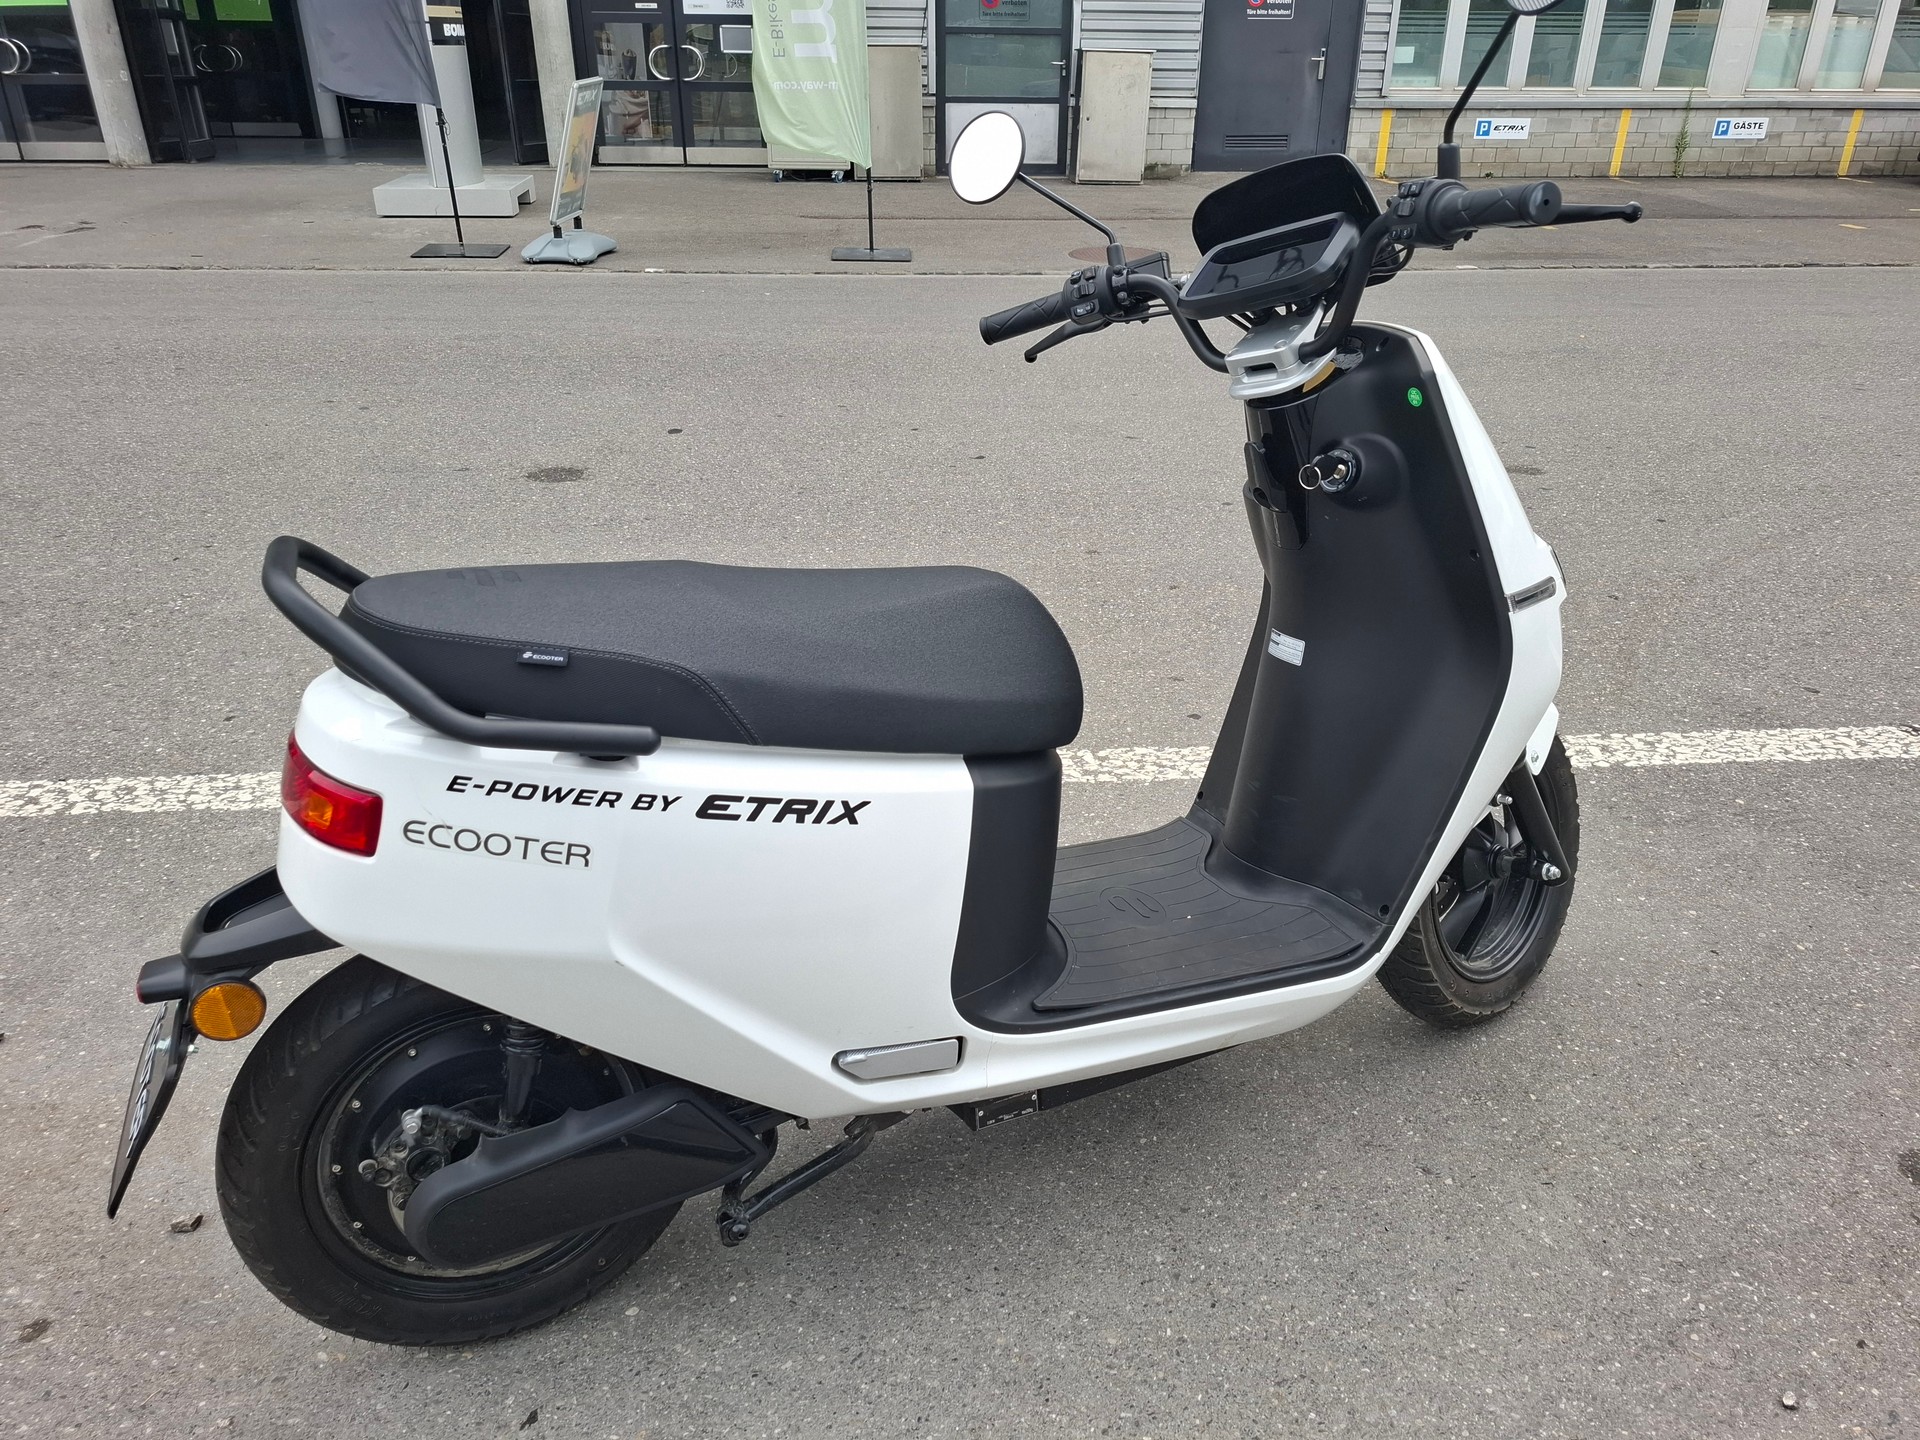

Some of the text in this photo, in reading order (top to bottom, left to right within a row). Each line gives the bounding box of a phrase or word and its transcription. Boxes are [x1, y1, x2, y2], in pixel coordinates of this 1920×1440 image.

[1479, 122, 1489, 135] P
[1718, 120, 1764, 135] P GÄSTE
[532, 653, 564, 662] ECOOTER
[446, 775, 872, 825] E-POWER BY ETRIX
[402, 819, 591, 868] ECOOTER
